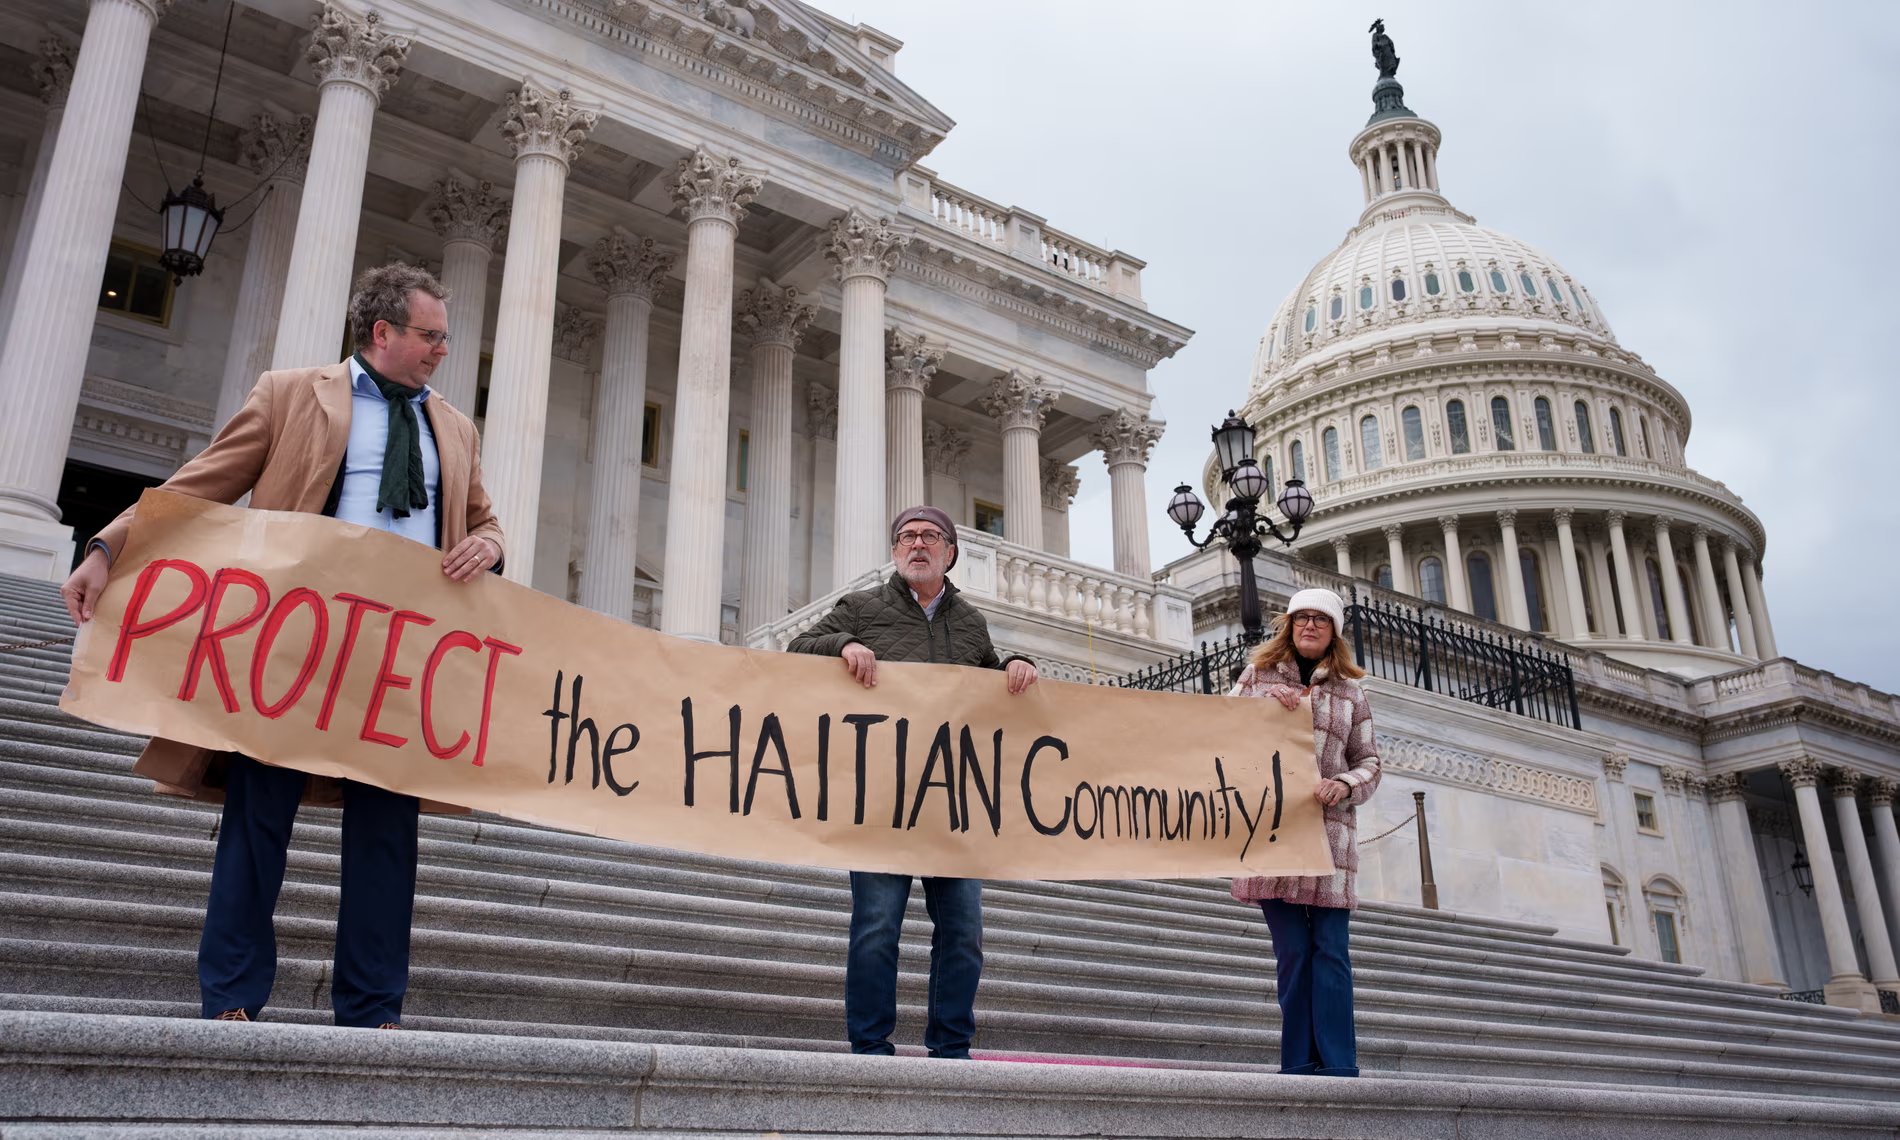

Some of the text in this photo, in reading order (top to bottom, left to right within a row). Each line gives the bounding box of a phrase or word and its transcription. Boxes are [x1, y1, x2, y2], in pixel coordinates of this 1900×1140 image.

[105, 558, 1282, 861] PROTECT the HAITIAN Community!
